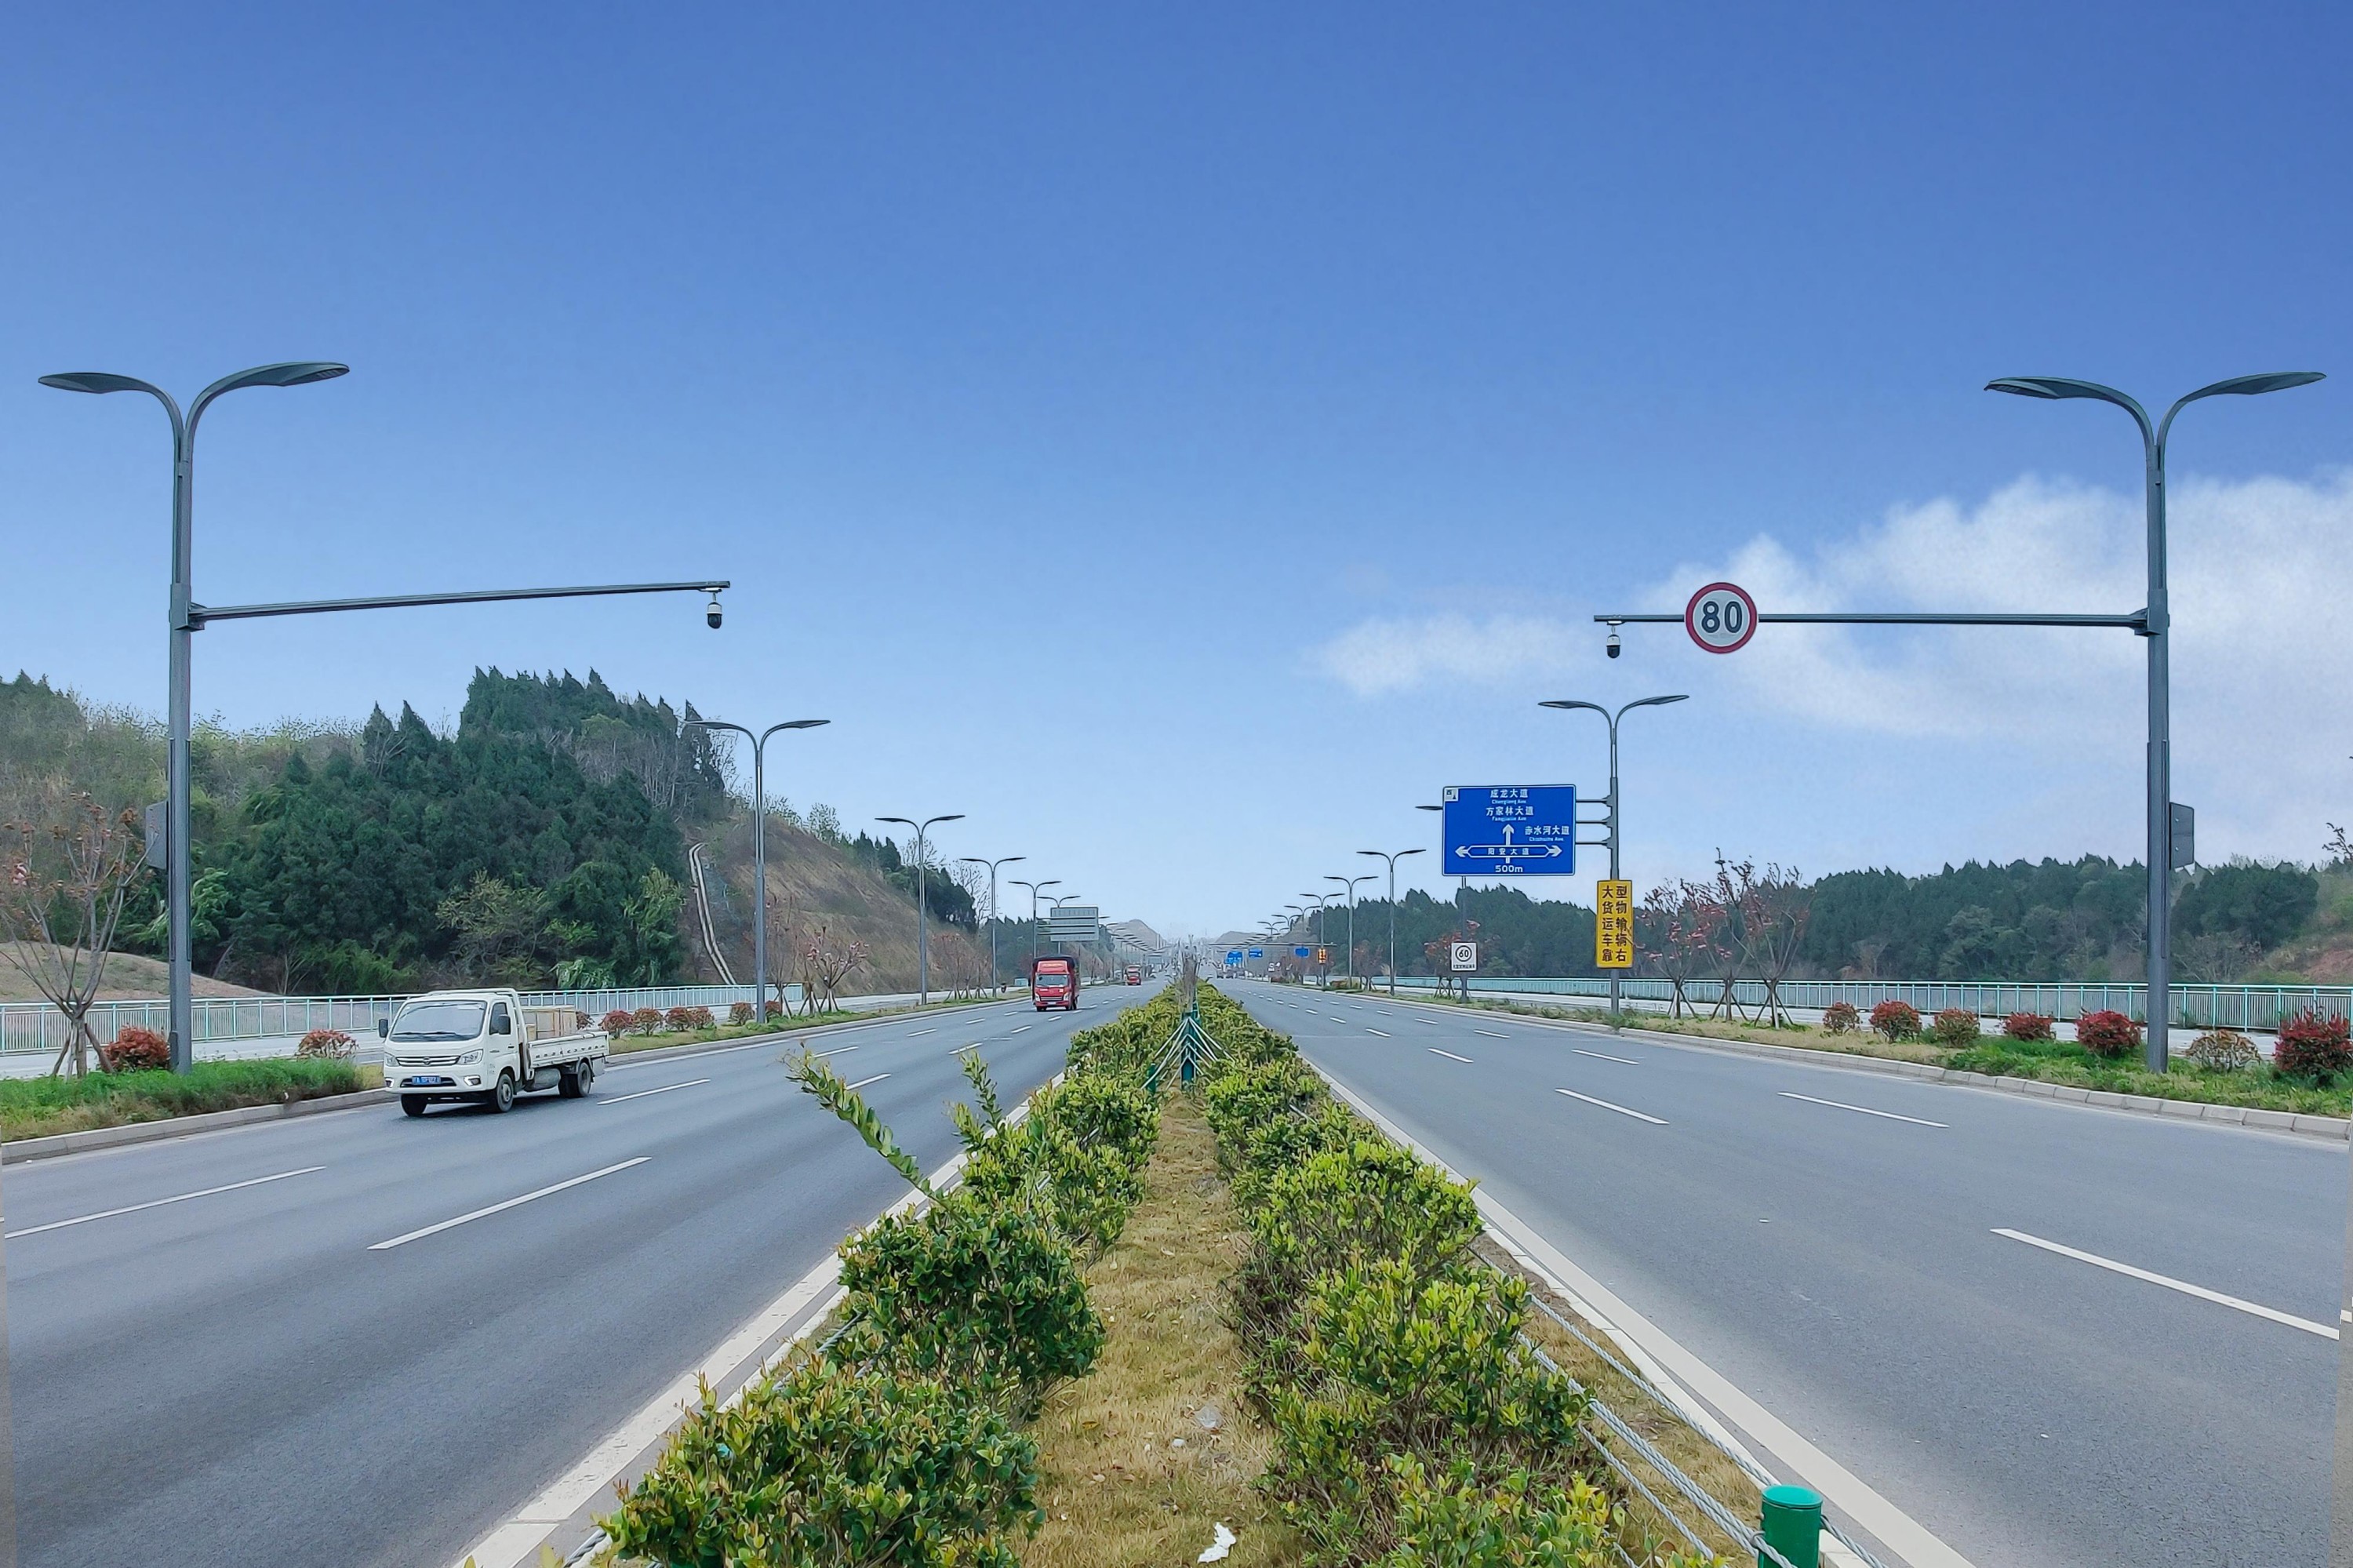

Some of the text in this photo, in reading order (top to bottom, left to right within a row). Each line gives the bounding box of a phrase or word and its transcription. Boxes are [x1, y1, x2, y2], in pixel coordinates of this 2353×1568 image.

[1701, 601, 1743, 633] 80
[1602, 885, 1627, 898] 大型
[1602, 900, 1627, 915] 货物
[1602, 917, 1627, 931] 运输
[1459, 949, 1469, 958] 60
[1602, 948, 1627, 962] 靠右
